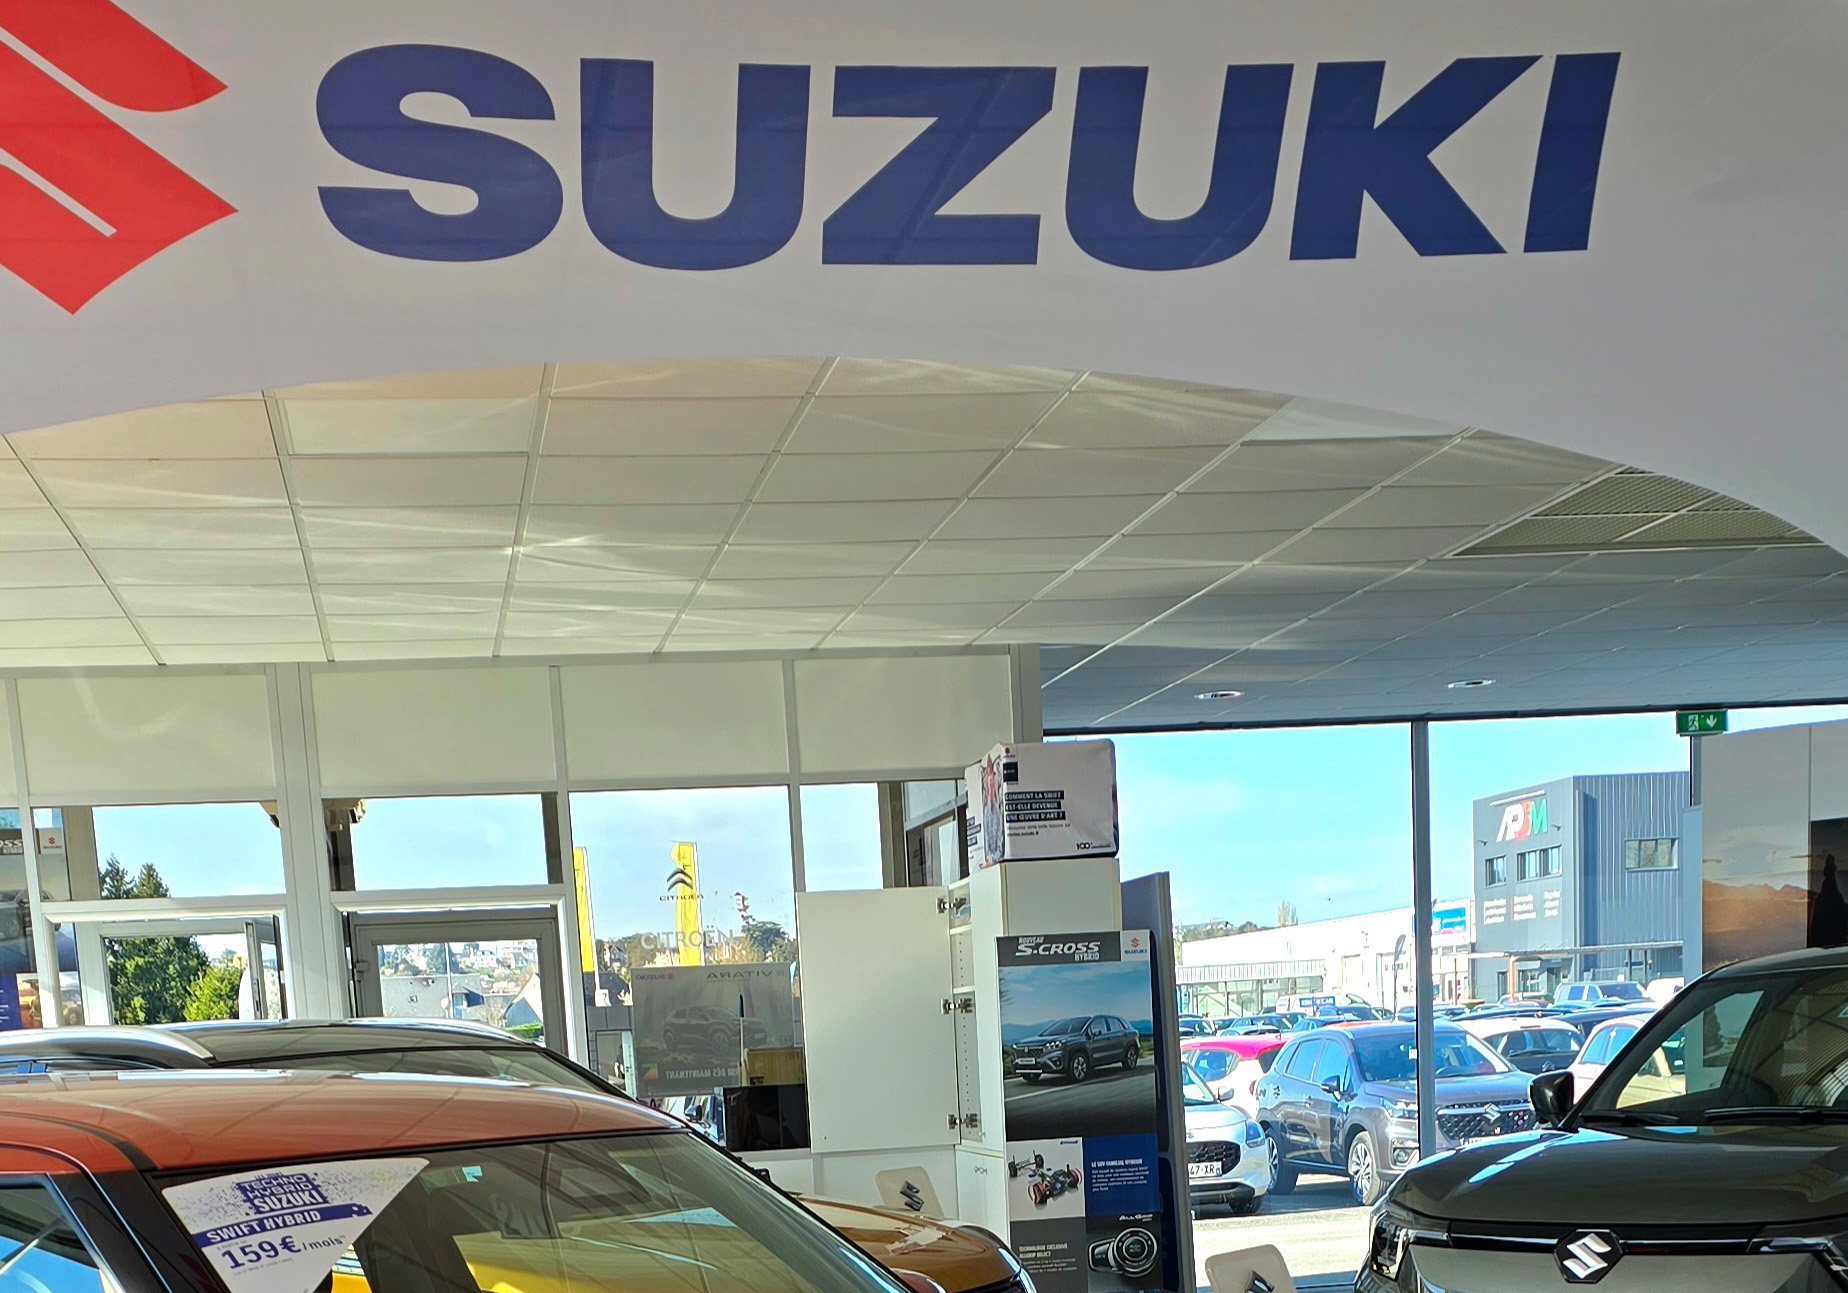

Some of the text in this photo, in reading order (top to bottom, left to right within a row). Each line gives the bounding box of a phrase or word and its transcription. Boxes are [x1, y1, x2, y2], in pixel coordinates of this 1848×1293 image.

[316, 43, 1621, 271] SUZUKI
[640, 925, 734, 950] CITROËN
[1074, 952, 1100, 962] HYBRID
[239, 1174, 306, 1192] TECHNO
[243, 1181, 313, 1200] HYBRID
[253, 1190, 324, 1213] SUZUKI
[206, 1211, 321, 1243] SWIFT HYBRID
